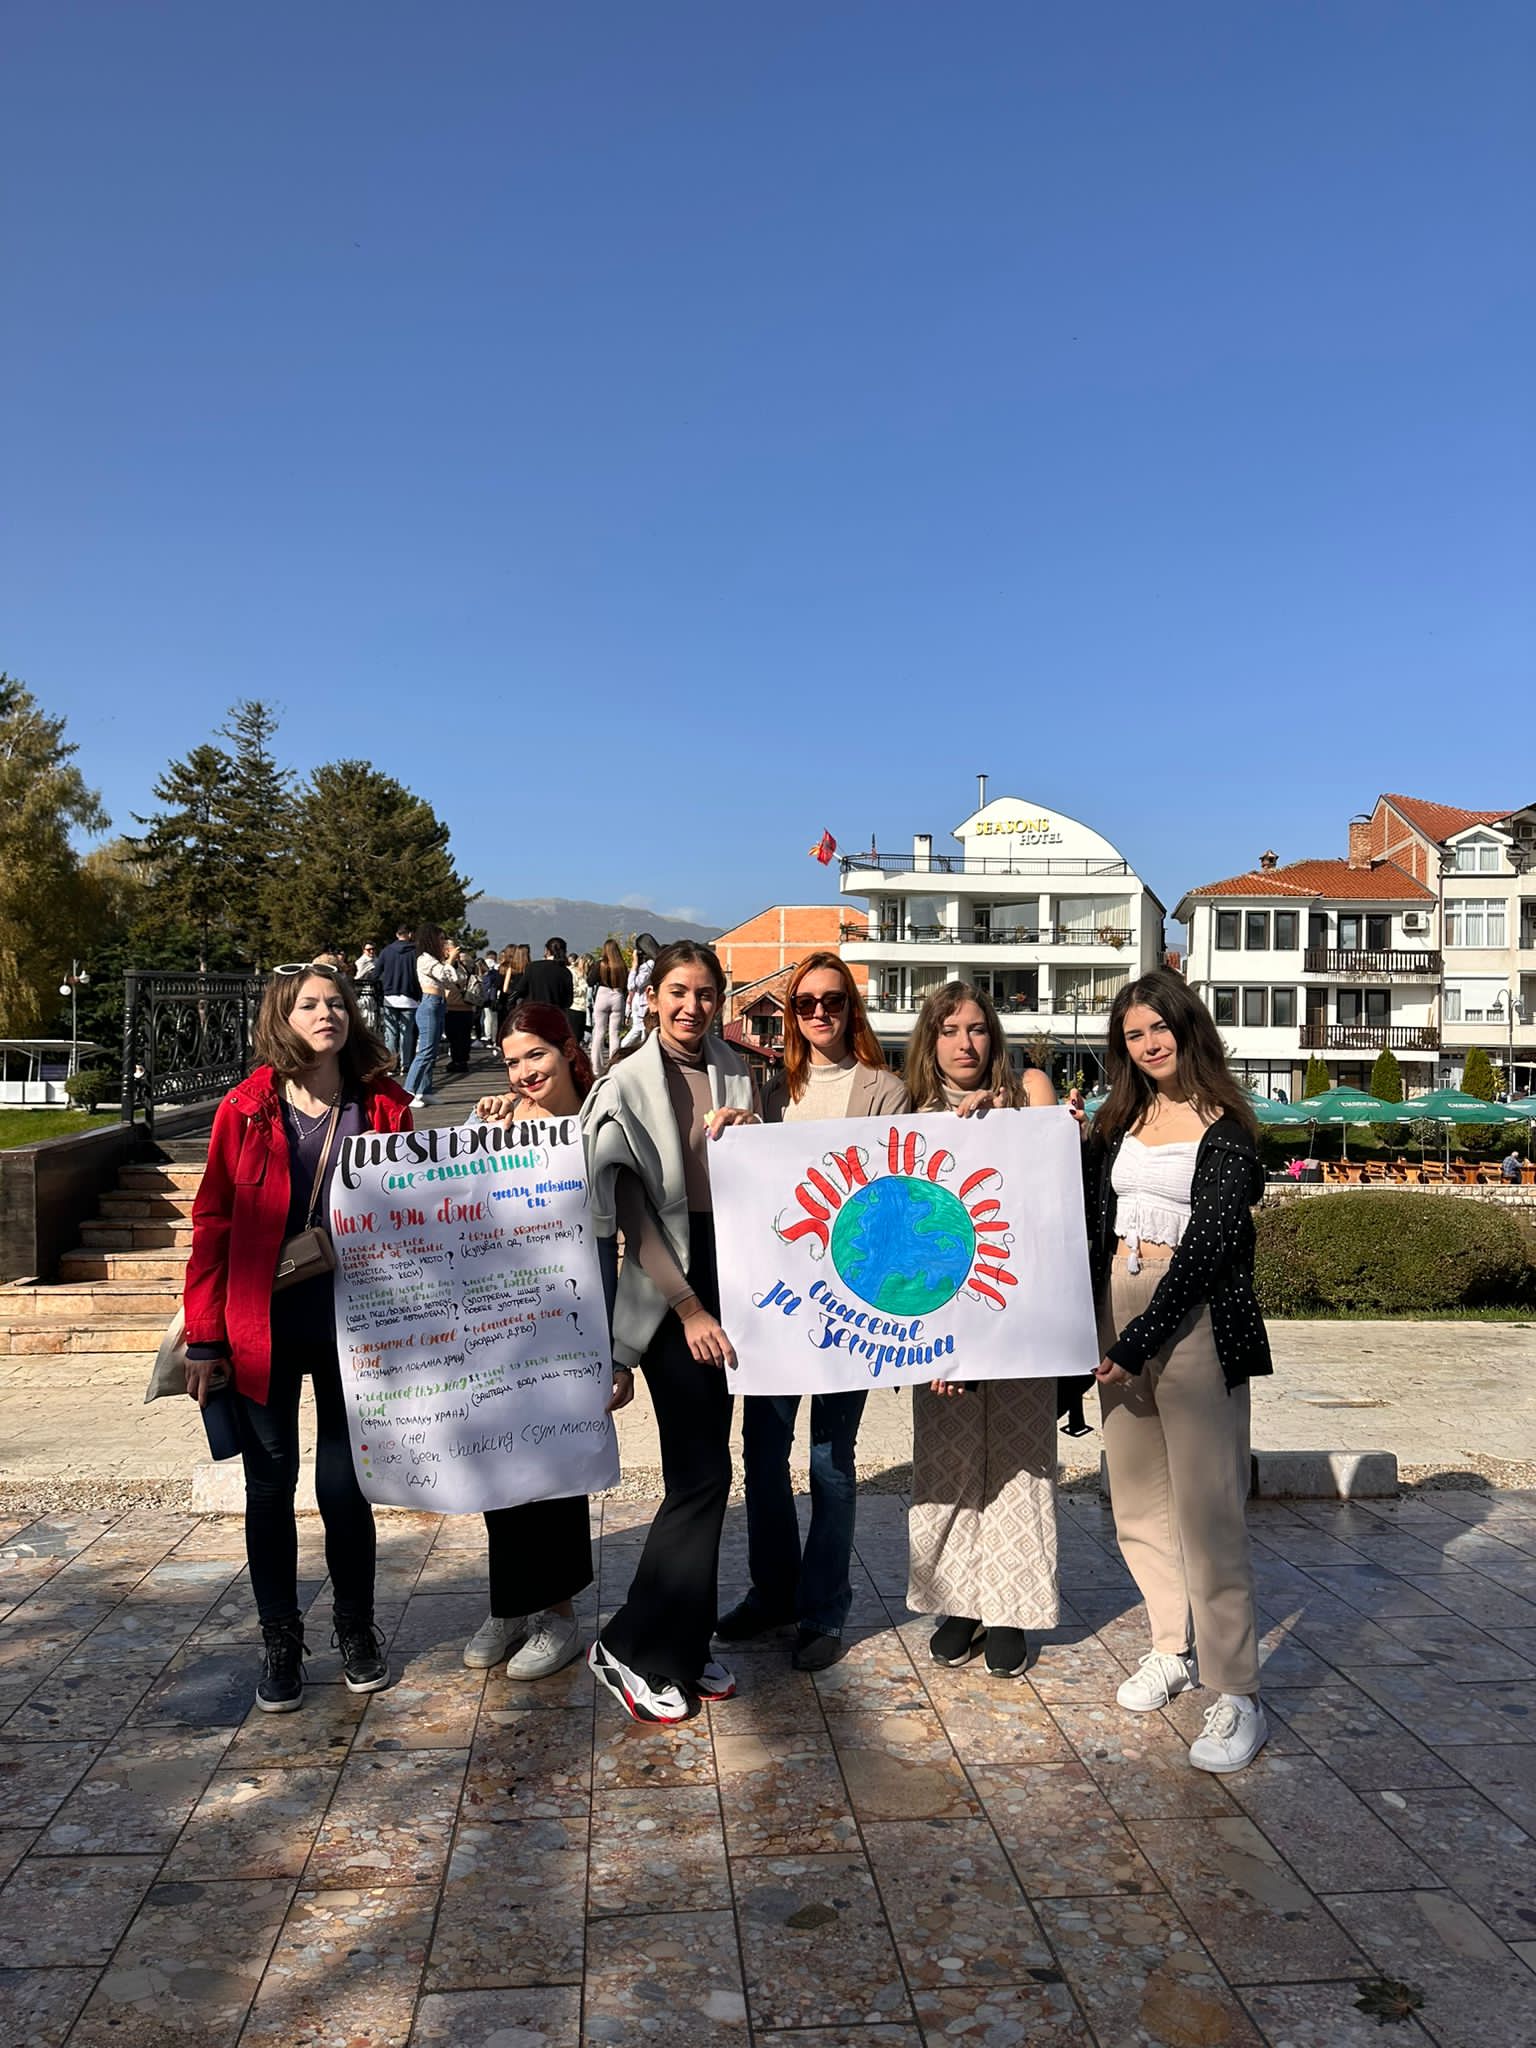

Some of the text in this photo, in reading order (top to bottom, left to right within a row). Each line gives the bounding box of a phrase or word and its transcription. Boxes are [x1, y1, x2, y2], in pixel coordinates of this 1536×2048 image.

[976, 818, 1050, 836] SEASONS
[1019, 832, 1063, 846] HOTEL
[877, 1126, 956, 1182] the
